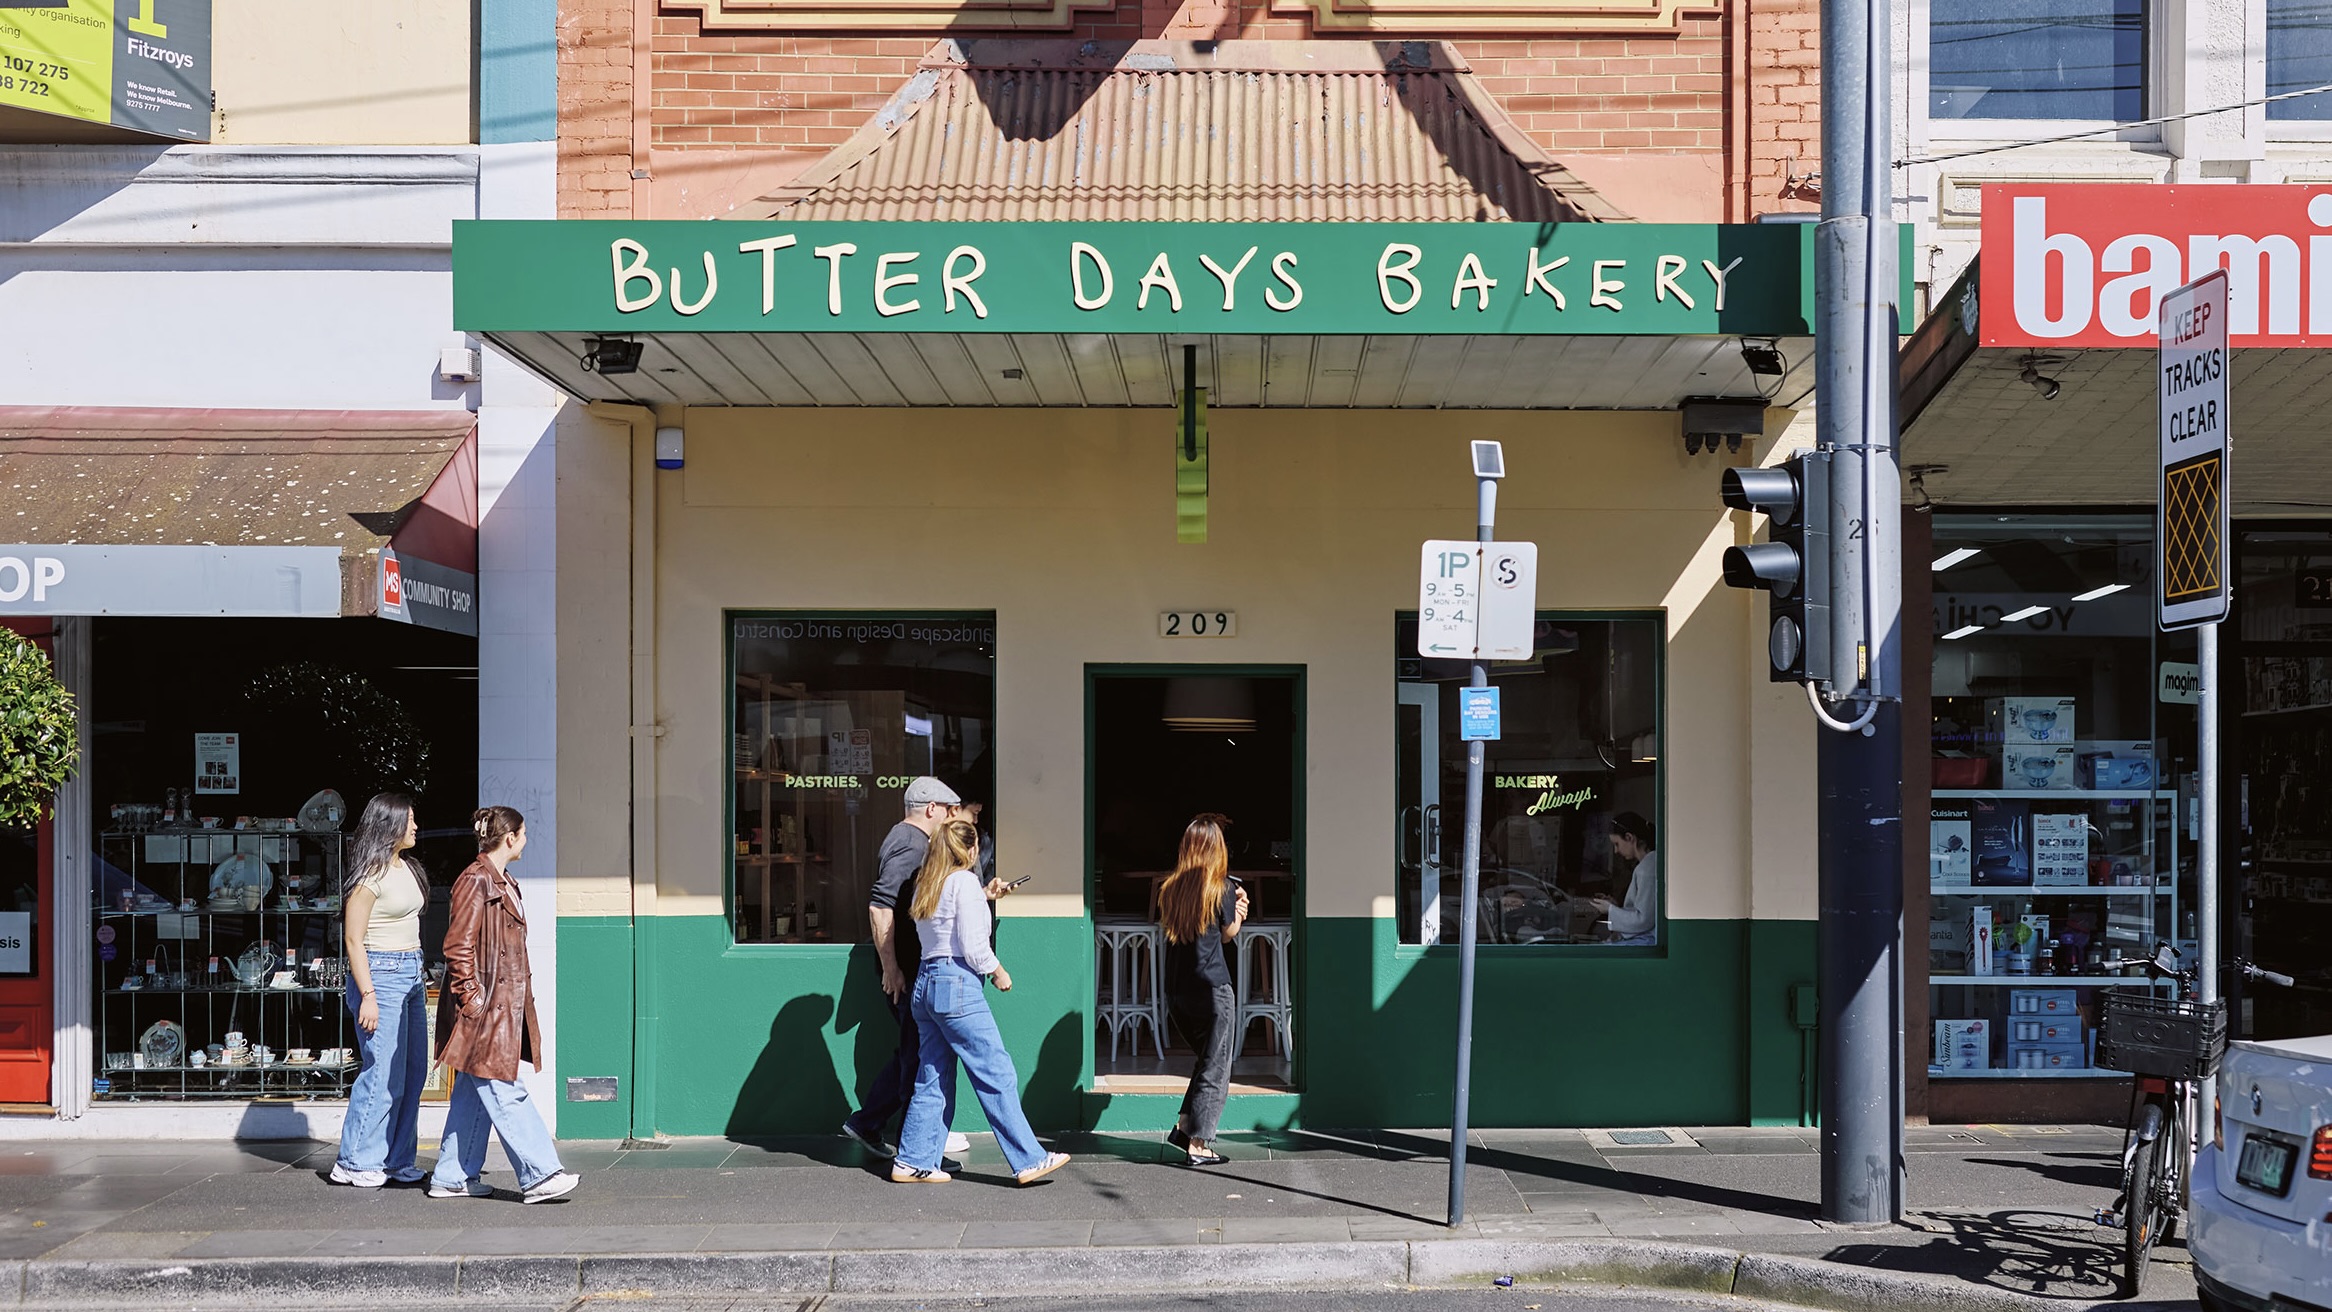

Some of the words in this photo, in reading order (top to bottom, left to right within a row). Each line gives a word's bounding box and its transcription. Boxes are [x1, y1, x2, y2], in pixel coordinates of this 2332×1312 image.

[39, 9, 106, 29] organisation
[127, 37, 194, 69] Fitzroys
[4, 55, 34, 73] 107
[39, 63, 69, 80] 275
[0, 75, 14, 89] 8
[19, 79, 49, 97] 722
[126, 80, 138, 90] We
[138, 83, 157, 94] know
[157, 87, 178, 98] Retail.
[126, 90, 138, 99] We
[138, 93, 156, 103] know
[157, 97, 193, 110] Melbourne.
[126, 99, 144, 109] 9275
[611, 233, 989, 319] BUTTER
[1071, 241, 1303, 312] DAYS
[1377, 242, 1744, 313] BAKERY
[2013, 194, 2332, 338] bami
[2174, 302, 2212, 346] KEEP
[2165, 348, 2221, 397] TRACKS
[2170, 400, 2217, 443] CLEAR
[1438, 552, 1470, 577] 1P
[0, 557, 65, 602] OP
[385, 570, 399, 593] MS
[402, 577, 450, 608] COMMUNITY
[451, 589, 471, 613] SHOP
[1166, 612, 1228, 636] 209
[785, 775, 862, 788] PASTRIES.
[1495, 775, 1559, 788] BAKERY.
[1526, 786, 1598, 816] Always.
[1930, 809, 1968, 818] Cuisinart
[0, 935, 21, 949] sis
[1940, 1022, 1952, 1067] Sunbeam
